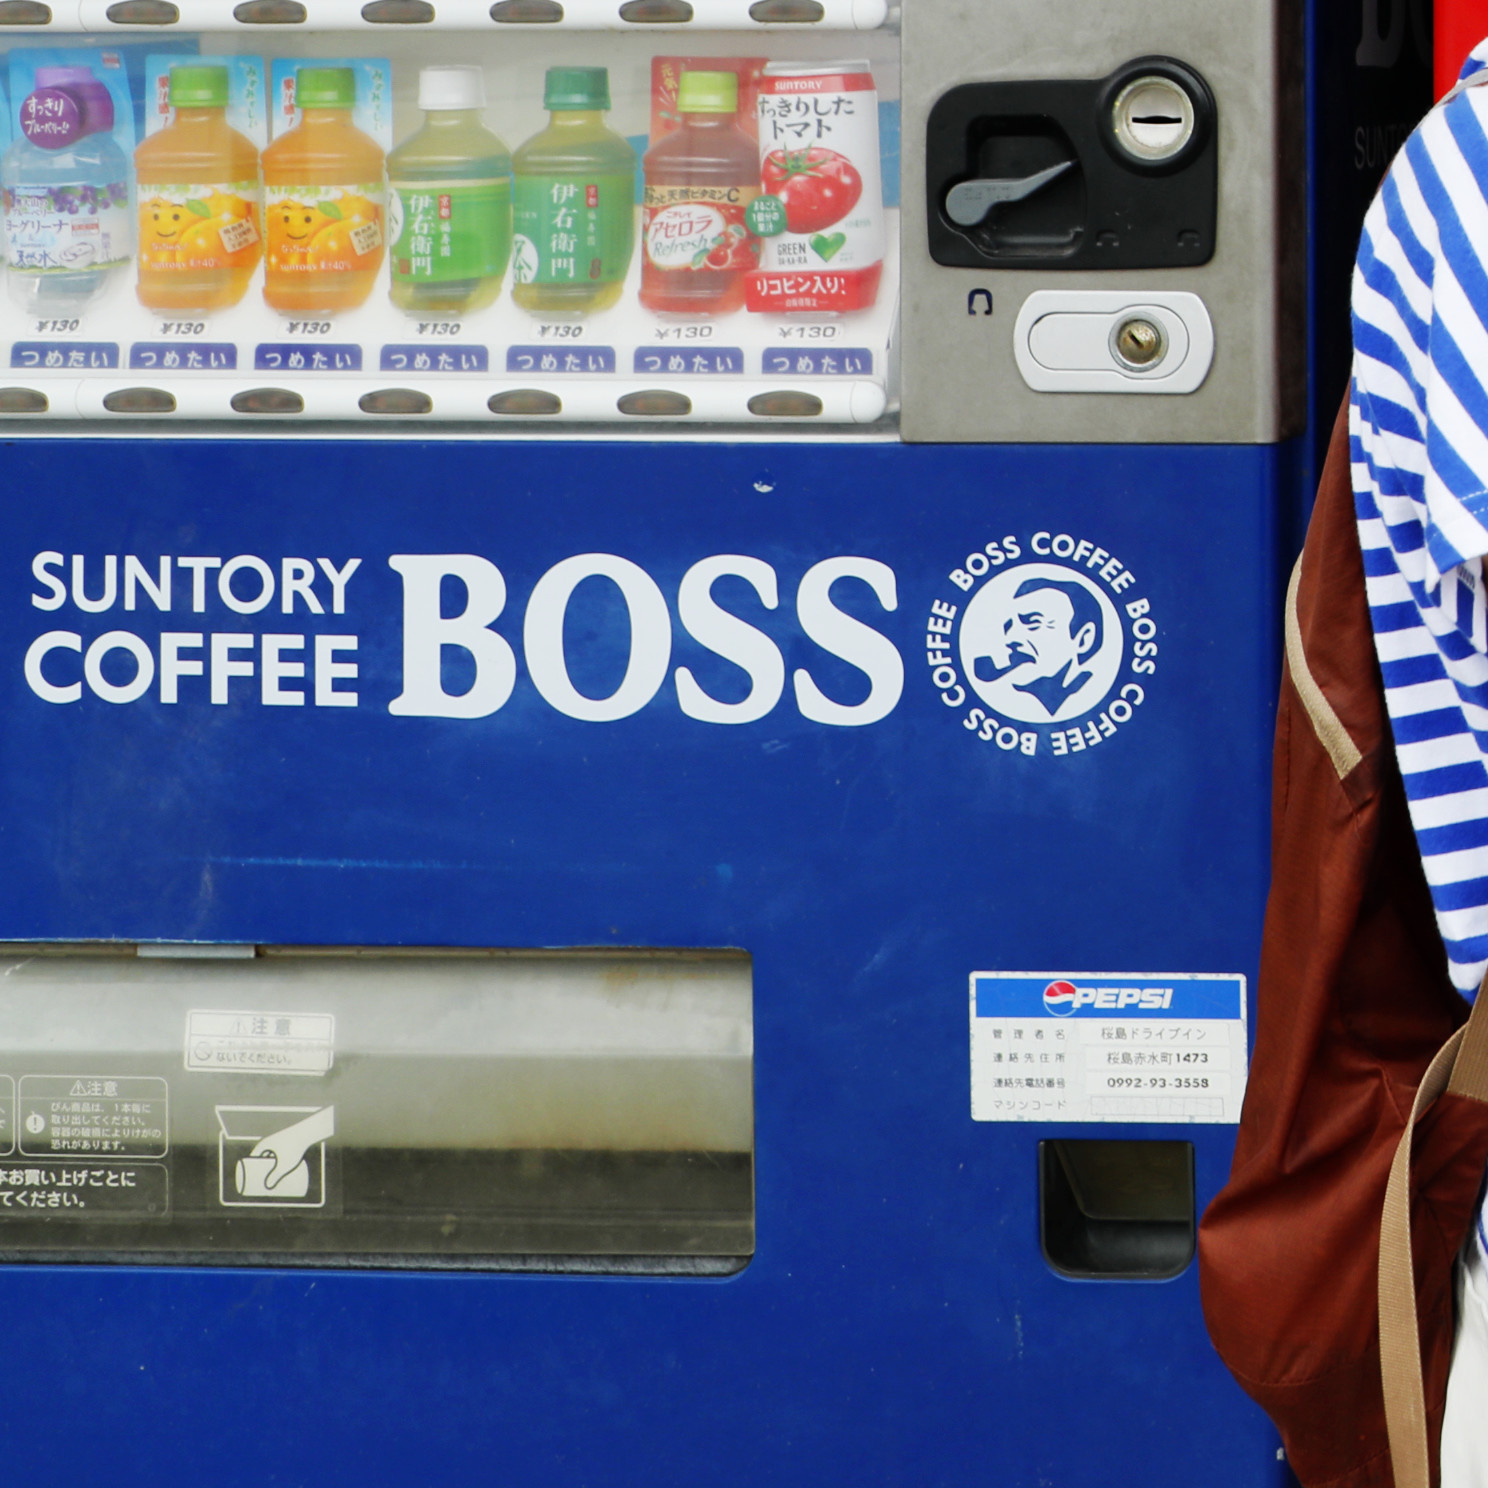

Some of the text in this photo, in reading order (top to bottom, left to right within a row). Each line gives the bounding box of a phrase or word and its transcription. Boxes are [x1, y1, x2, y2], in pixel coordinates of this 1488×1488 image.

[773, 118, 832, 140] トマト
[409, 195, 434, 275] 伊右衛門
[551, 183, 578, 278] 伊右衛門
[777, 242, 806, 256] GREEN
[949, 531, 1136, 594] BOSS COFFEE
[32, 551, 362, 614] SUNTORY
[389, 553, 905, 725] BOSS
[24, 630, 358, 707] COFFEE
[926, 599, 1038, 756] BOSS COFFEE
[1050, 598, 1158, 756] BOSS COFFEE
[1072, 988, 1173, 1009] PEPSI
[251, 1017, 292, 1036] 注意
[992, 1027, 1207, 1041] 管理者名 桜島ドライブイン
[992, 1052, 1209, 1065] 連絡先住所 桜島赤水町1473
[87, 1080, 118, 1097] 注意
[992, 1077, 1209, 1089] 連絡先電話番号 0992-93-3558
[993, 1099, 1067, 1110] マシンコード
[51, 1114, 147, 1126] 取り出してください。
[51, 1139, 126, 1151] 恐れがあります。
